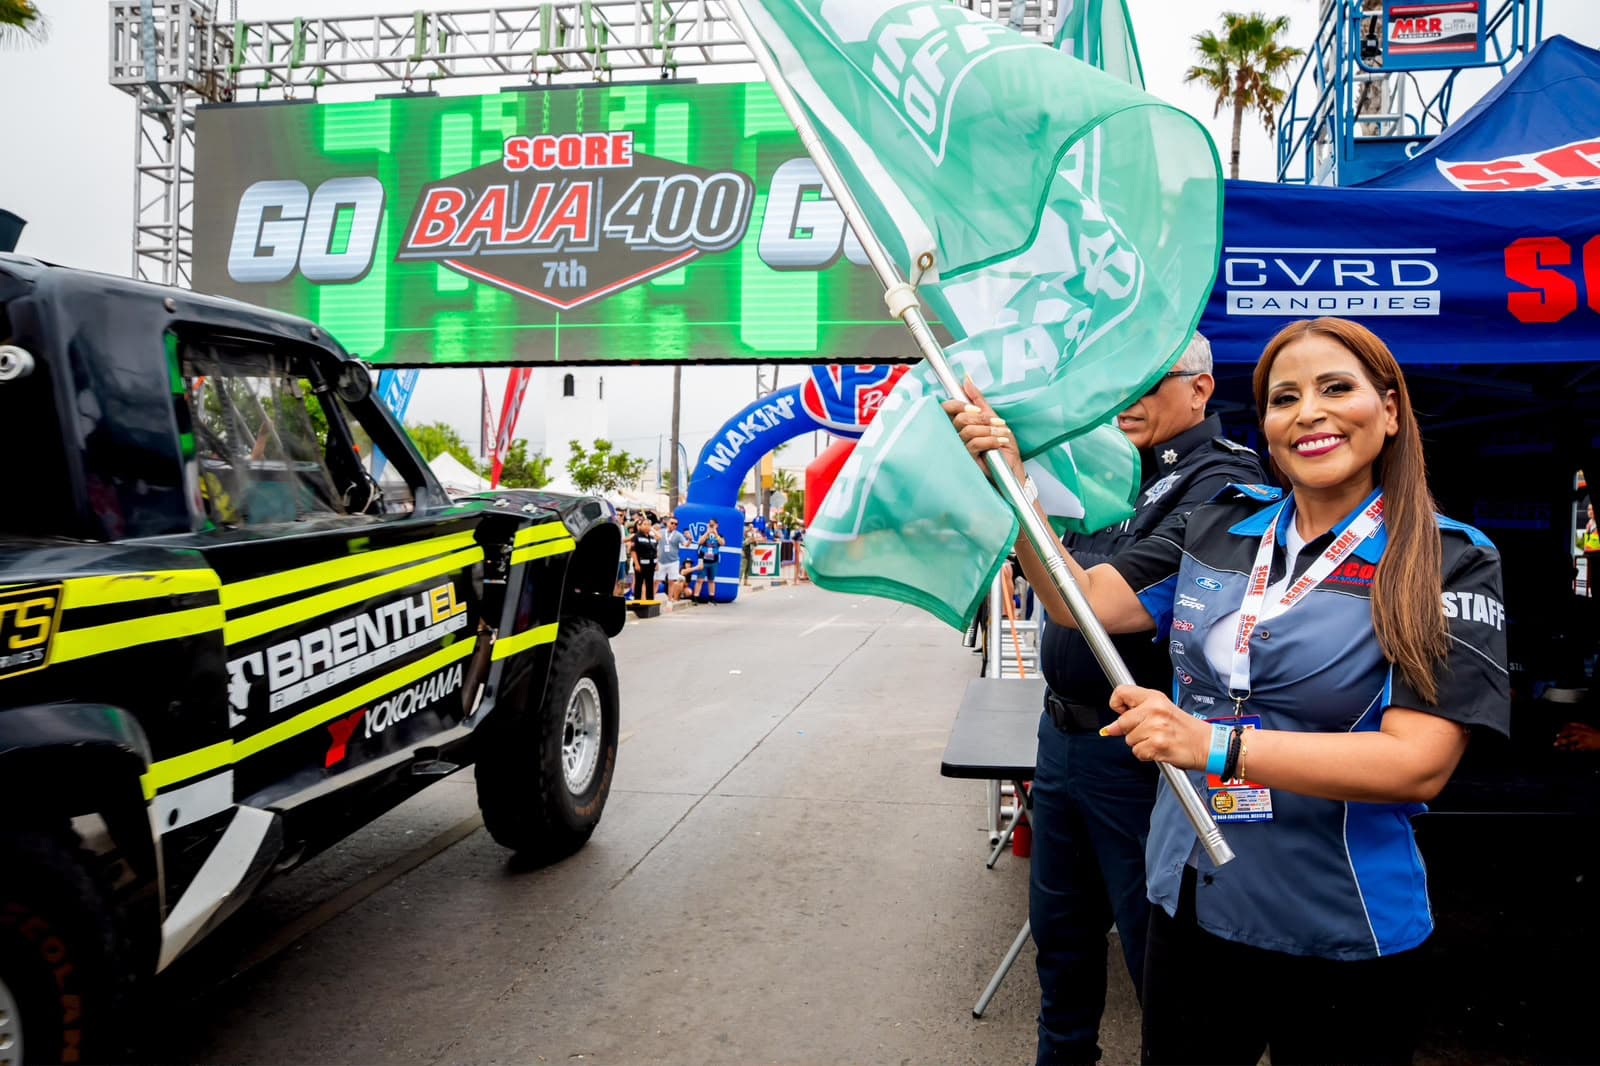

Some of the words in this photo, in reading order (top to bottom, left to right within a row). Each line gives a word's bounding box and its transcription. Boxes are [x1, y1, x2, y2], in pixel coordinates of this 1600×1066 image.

[1392, 18, 1442, 39] MRR
[504, 131, 632, 171] SCORE
[227, 175, 385, 284] GO
[407, 181, 596, 249] BAJA
[604, 172, 750, 248] 400
[758, 157, 870, 267] G
[542, 258, 587, 289] 7th
[1224, 258, 1440, 287] CVRD
[1504, 236, 1600, 323] S
[1236, 296, 1432, 311] CANOPIES
[1325, 529, 1357, 562] SCORE
[1254, 565, 1269, 596] SCORE
[1280, 575, 1314, 606] SCORE
[1440, 591, 1505, 632] STAFF
[266, 582, 468, 692] BRENTHEL
[363, 663, 463, 739] YOKOHAMA
